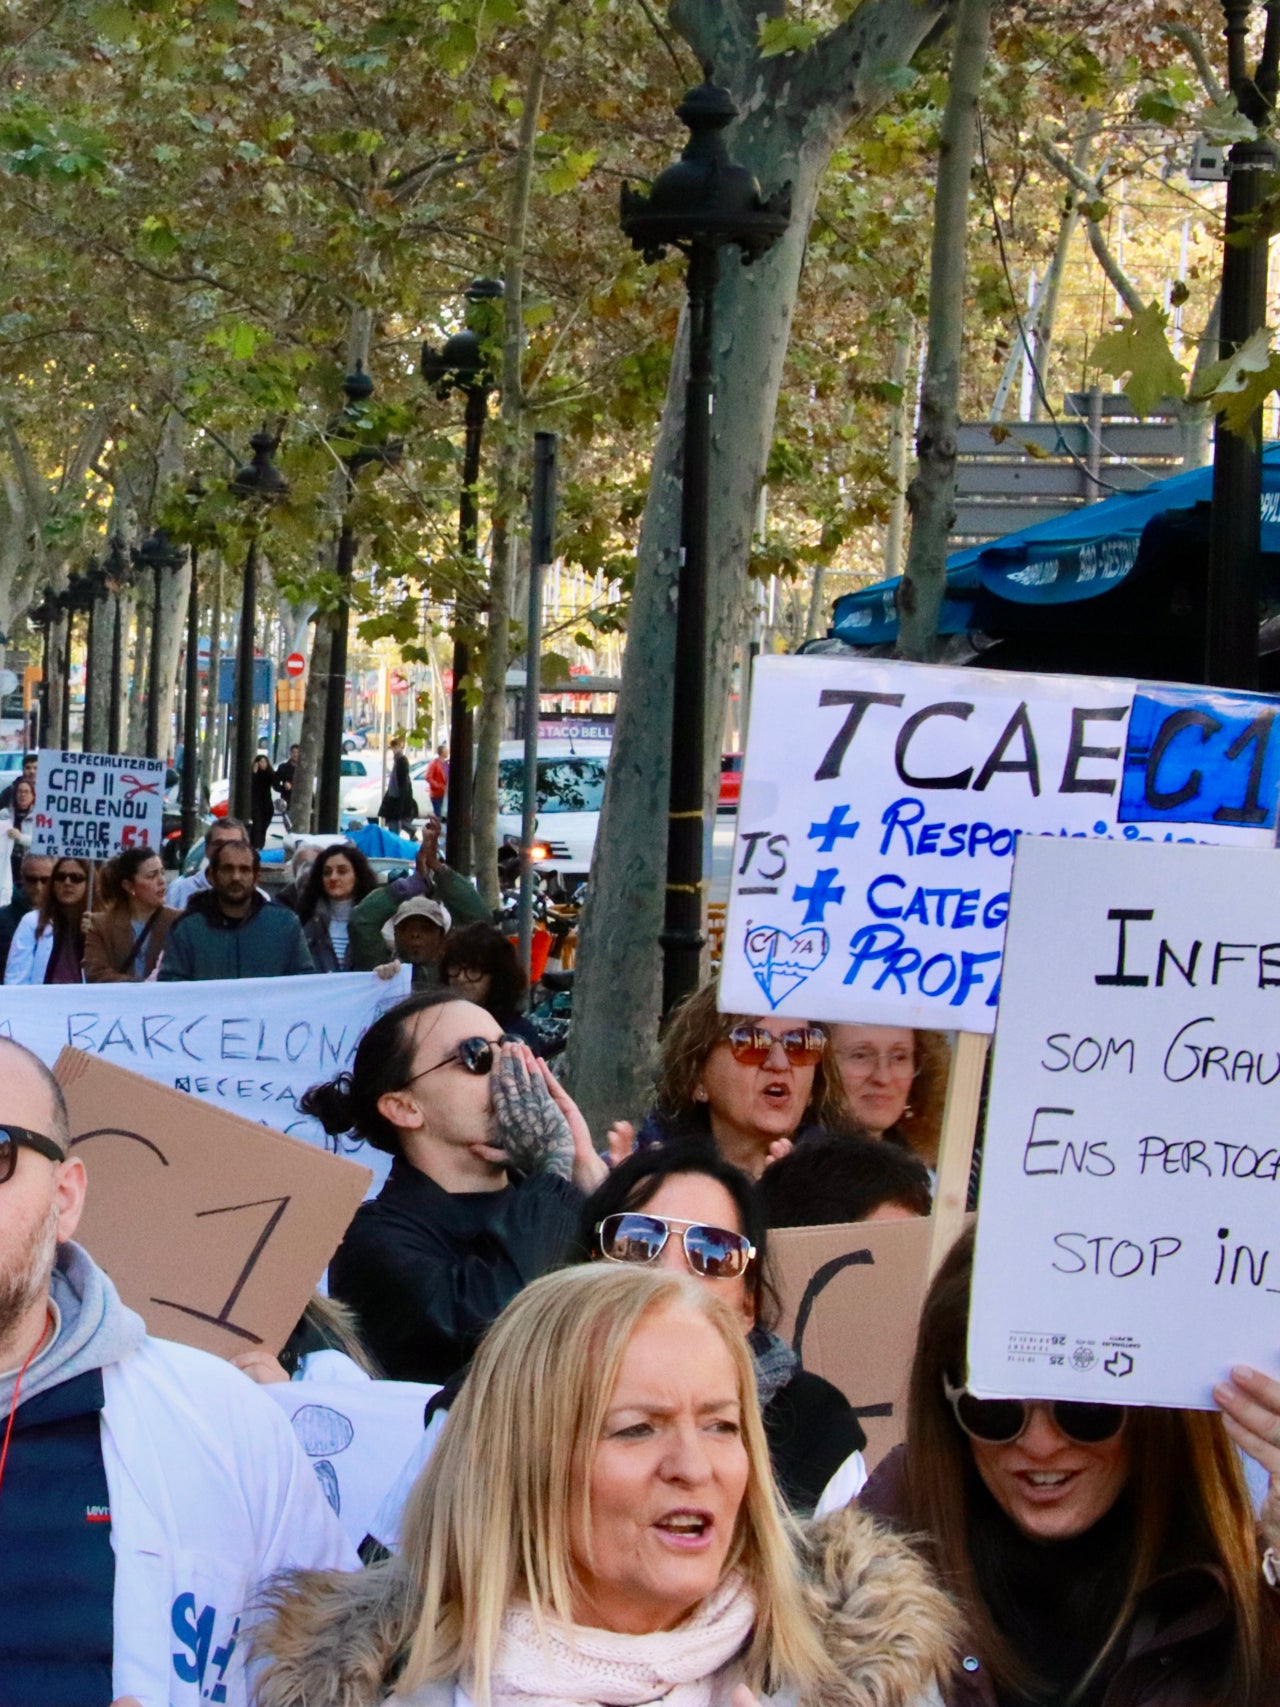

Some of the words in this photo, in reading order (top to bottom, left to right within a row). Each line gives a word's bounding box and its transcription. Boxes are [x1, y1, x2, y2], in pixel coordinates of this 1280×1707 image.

[547, 726, 579, 738] TACO
[581, 726, 613, 738] BELL
[814, 689, 1130, 798] TCAE
[48, 768, 96, 794] CAP
[46, 794, 148, 820] POBLENOU
[58, 820, 110, 842] TCAE
[866, 874, 1010, 929] CATEG
[1041, 1033, 1135, 1074] SOM
[175, 1076, 297, 1101] NECESA
[1051, 1232, 1183, 1278] STOP
